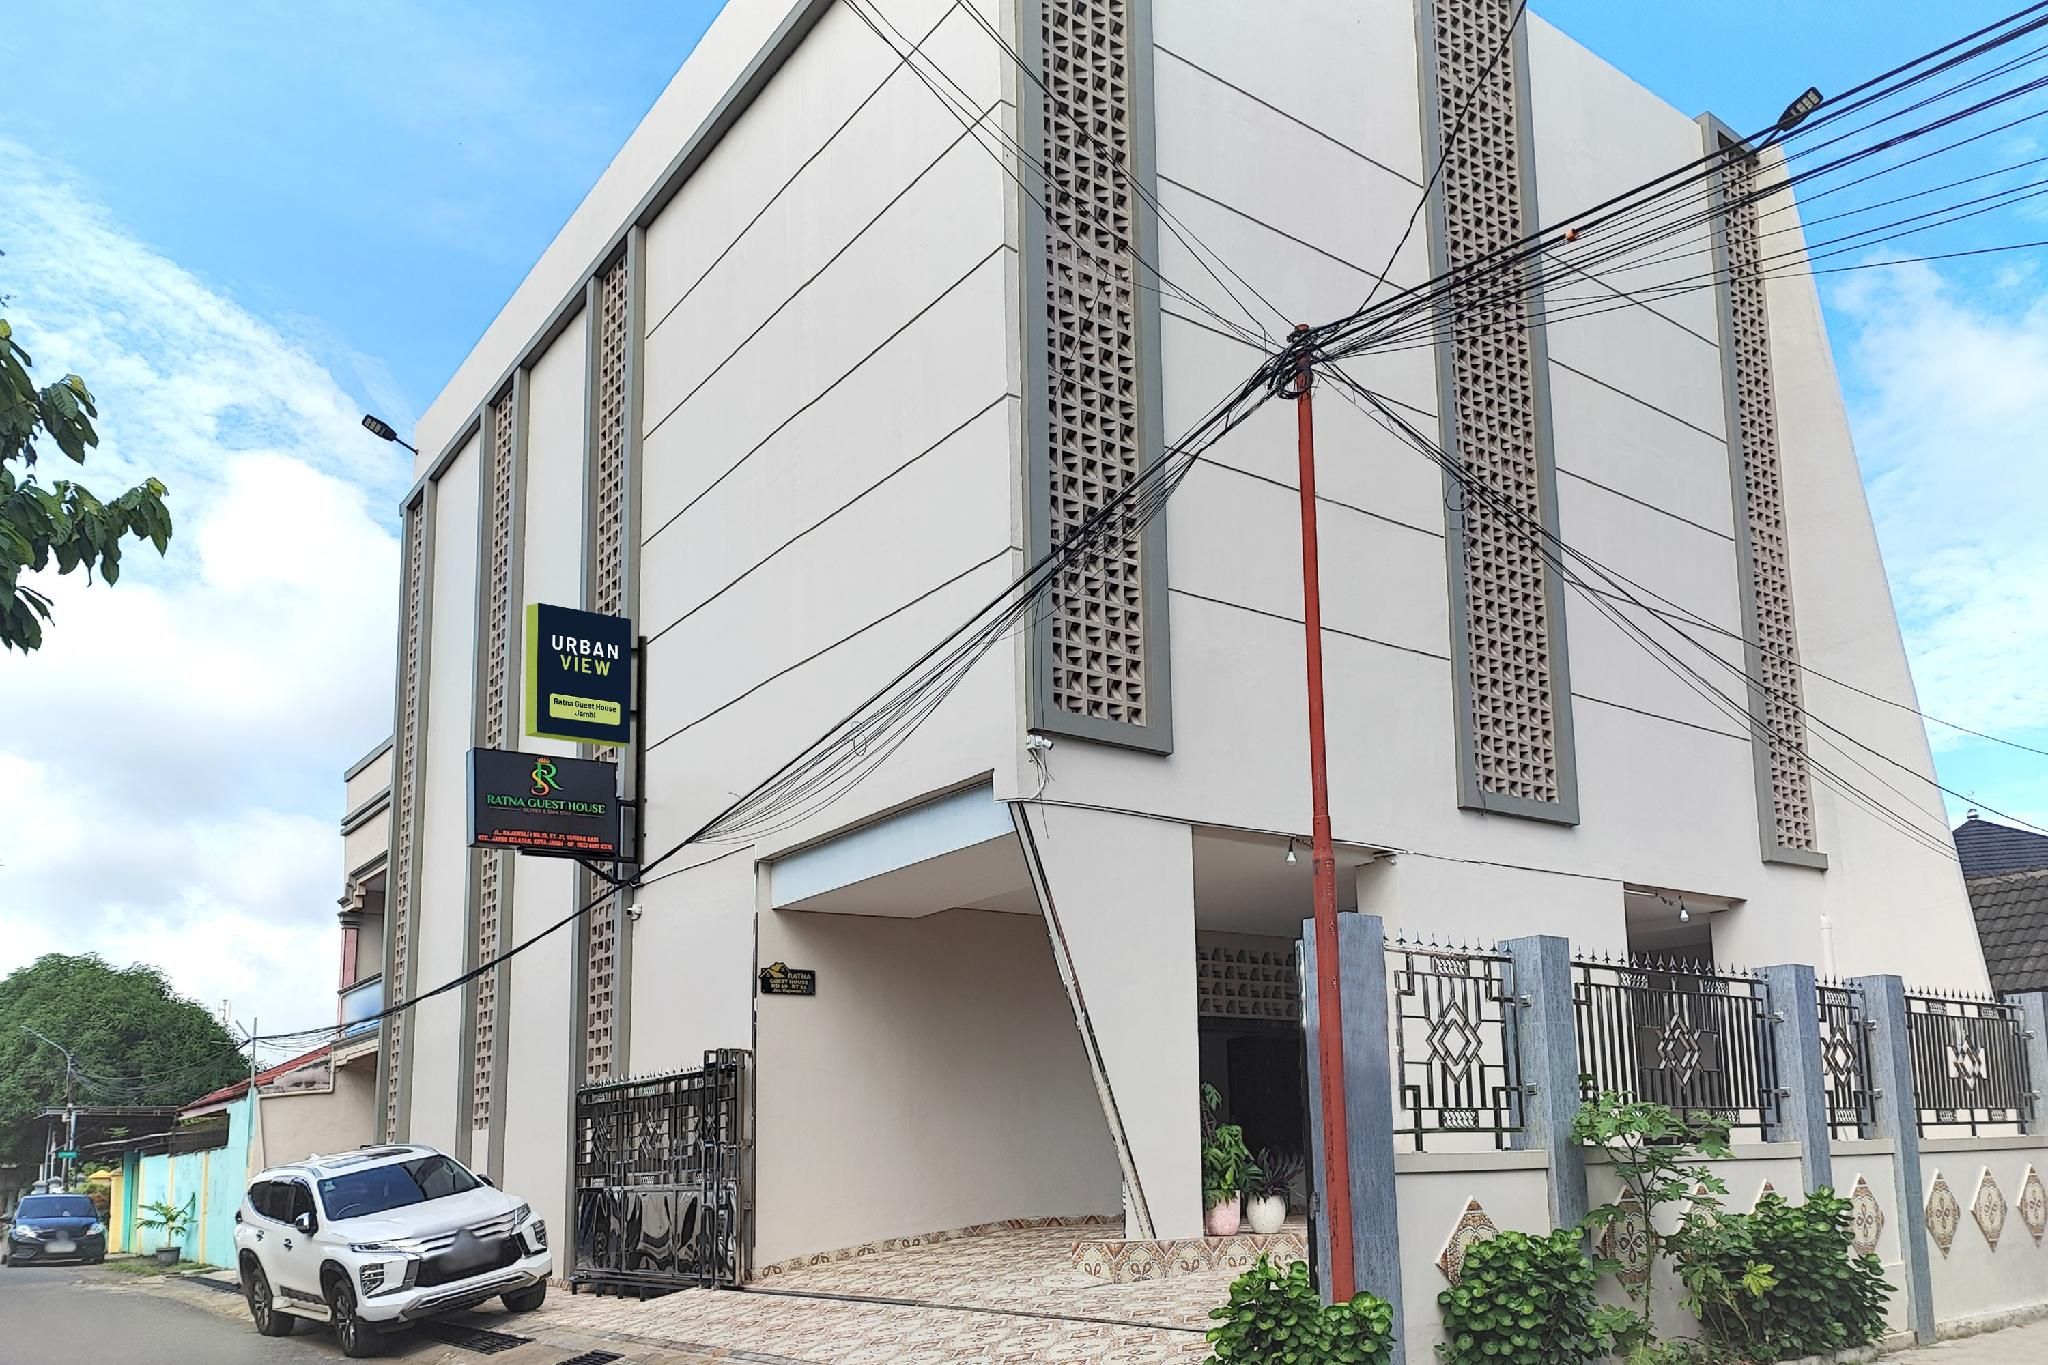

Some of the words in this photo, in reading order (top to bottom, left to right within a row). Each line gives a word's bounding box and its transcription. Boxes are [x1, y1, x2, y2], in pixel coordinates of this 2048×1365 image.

[551, 634, 619, 660] URBAN
[559, 654, 611, 677] VIEW
[553, 697, 574, 707] Ratna
[574, 700, 595, 710] Guest
[595, 703, 617, 713] House
[574, 709, 596, 718] Jambi
[487, 794, 526, 807] RATNA
[527, 798, 566, 810] GUEST
[567, 801, 606, 814] HOUSE
